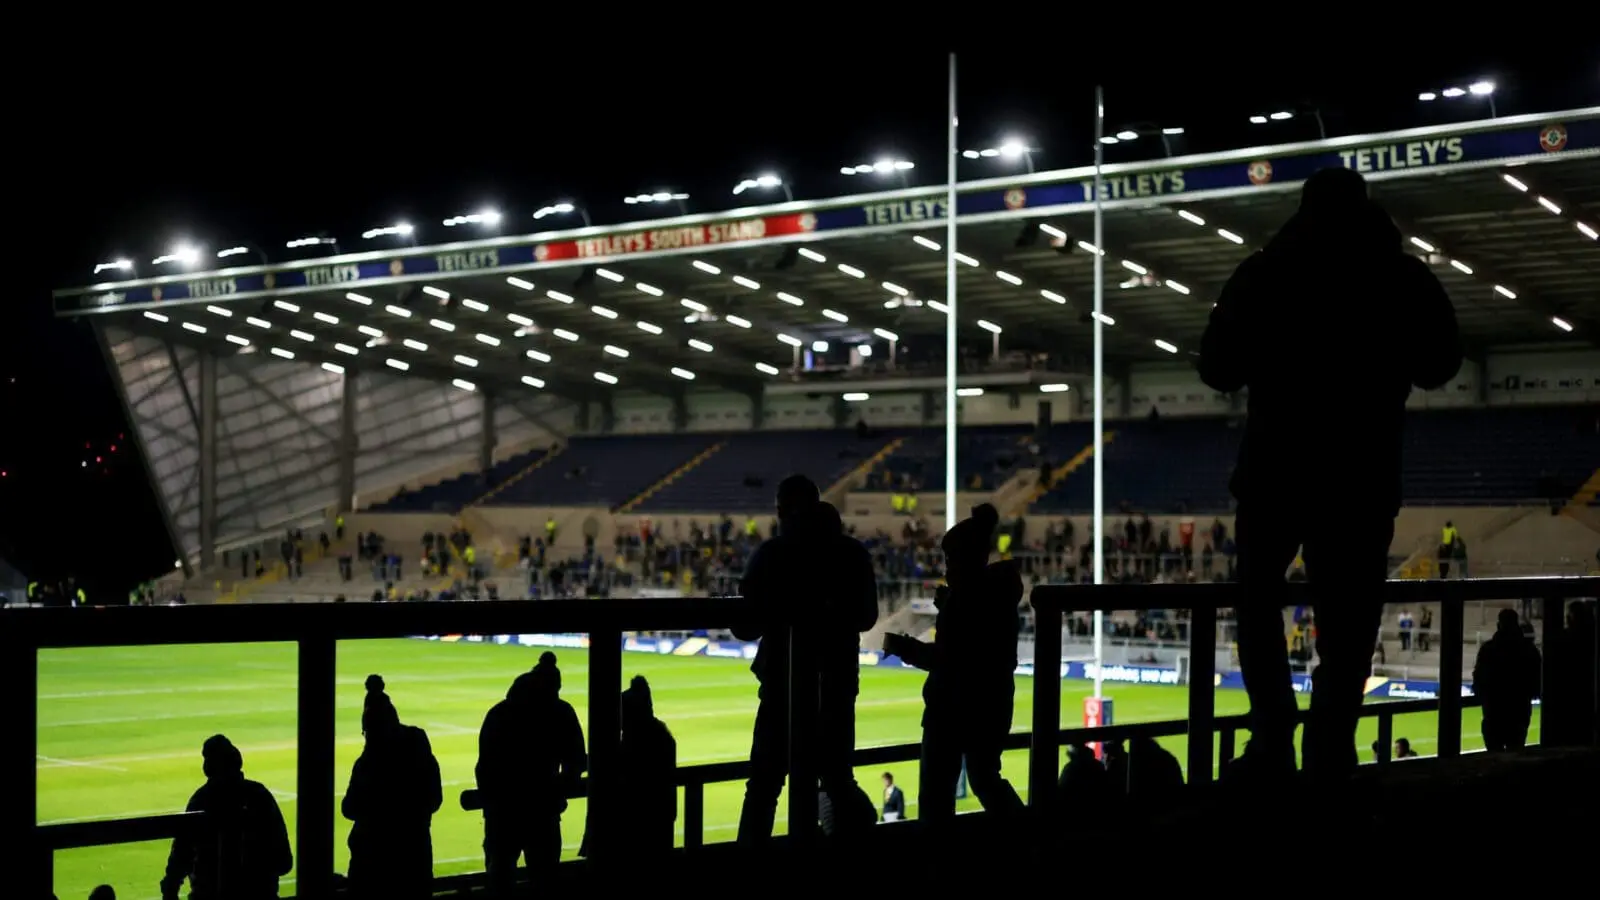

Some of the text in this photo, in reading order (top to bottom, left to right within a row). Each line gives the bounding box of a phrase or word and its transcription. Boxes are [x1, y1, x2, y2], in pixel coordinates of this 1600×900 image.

[1339, 138, 1463, 172] TETLEY'S
[1081, 170, 1185, 202] TETLEY'S
[650, 227, 705, 248] SOUTH
[708, 219, 765, 242] STAND
[437, 250, 498, 271] TETLEY'S
